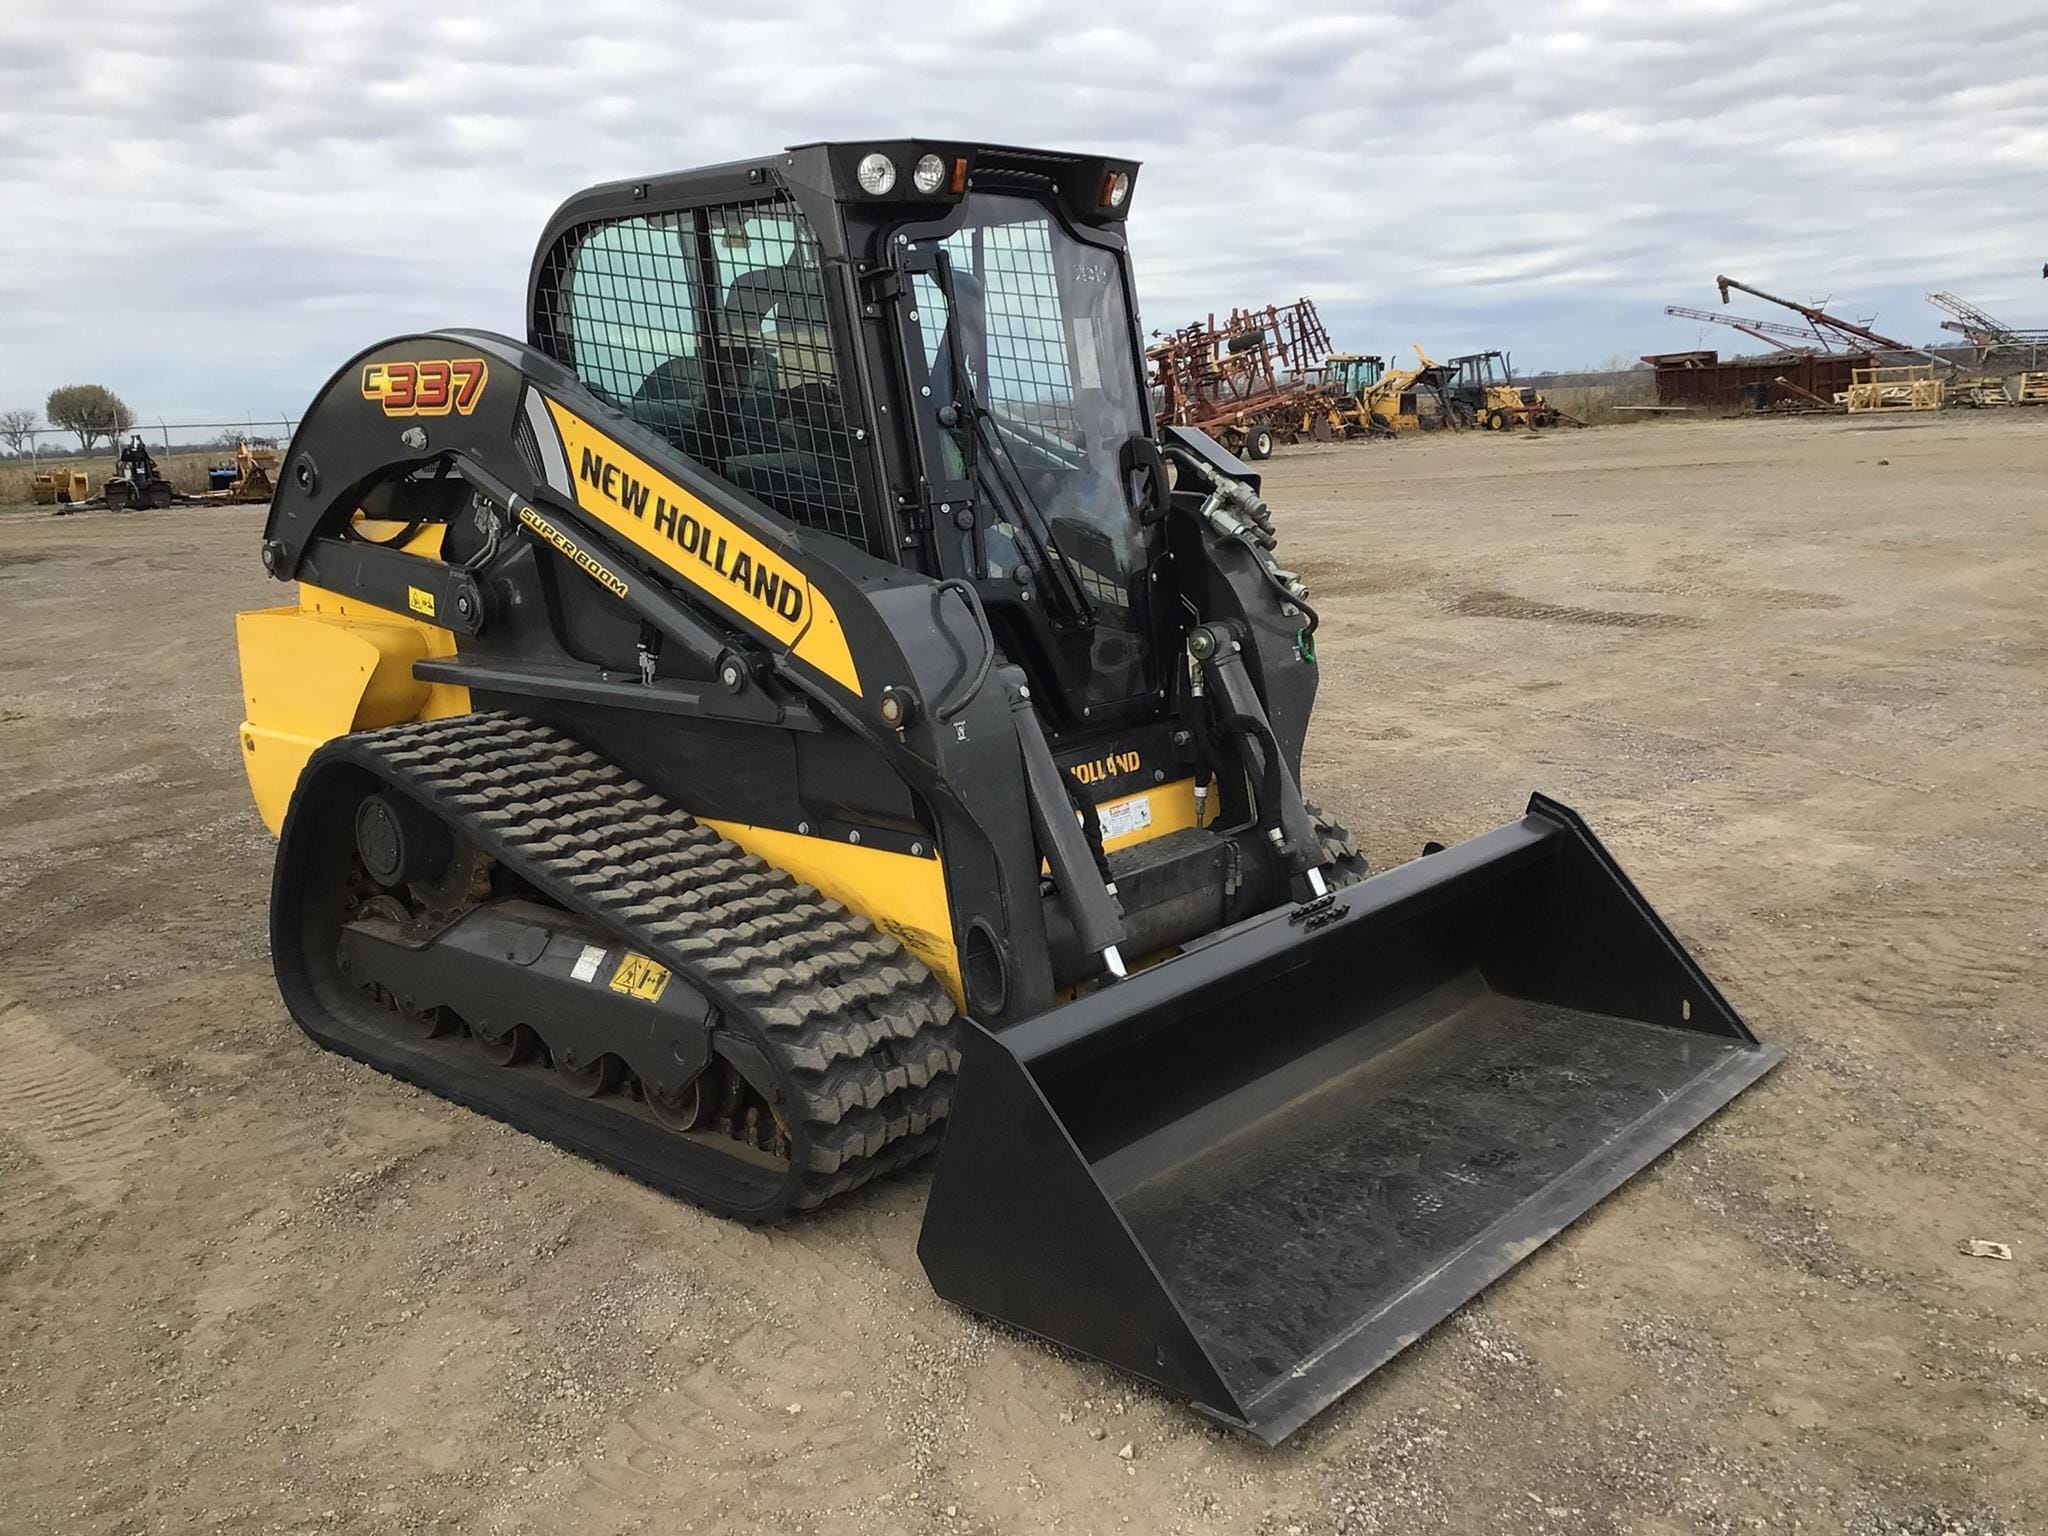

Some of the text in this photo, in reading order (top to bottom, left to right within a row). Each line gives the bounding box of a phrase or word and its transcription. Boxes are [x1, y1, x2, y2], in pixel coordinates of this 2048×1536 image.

[521, 507, 629, 600] SUPER BOOM
[580, 446, 803, 624] NEW HOLLAND
